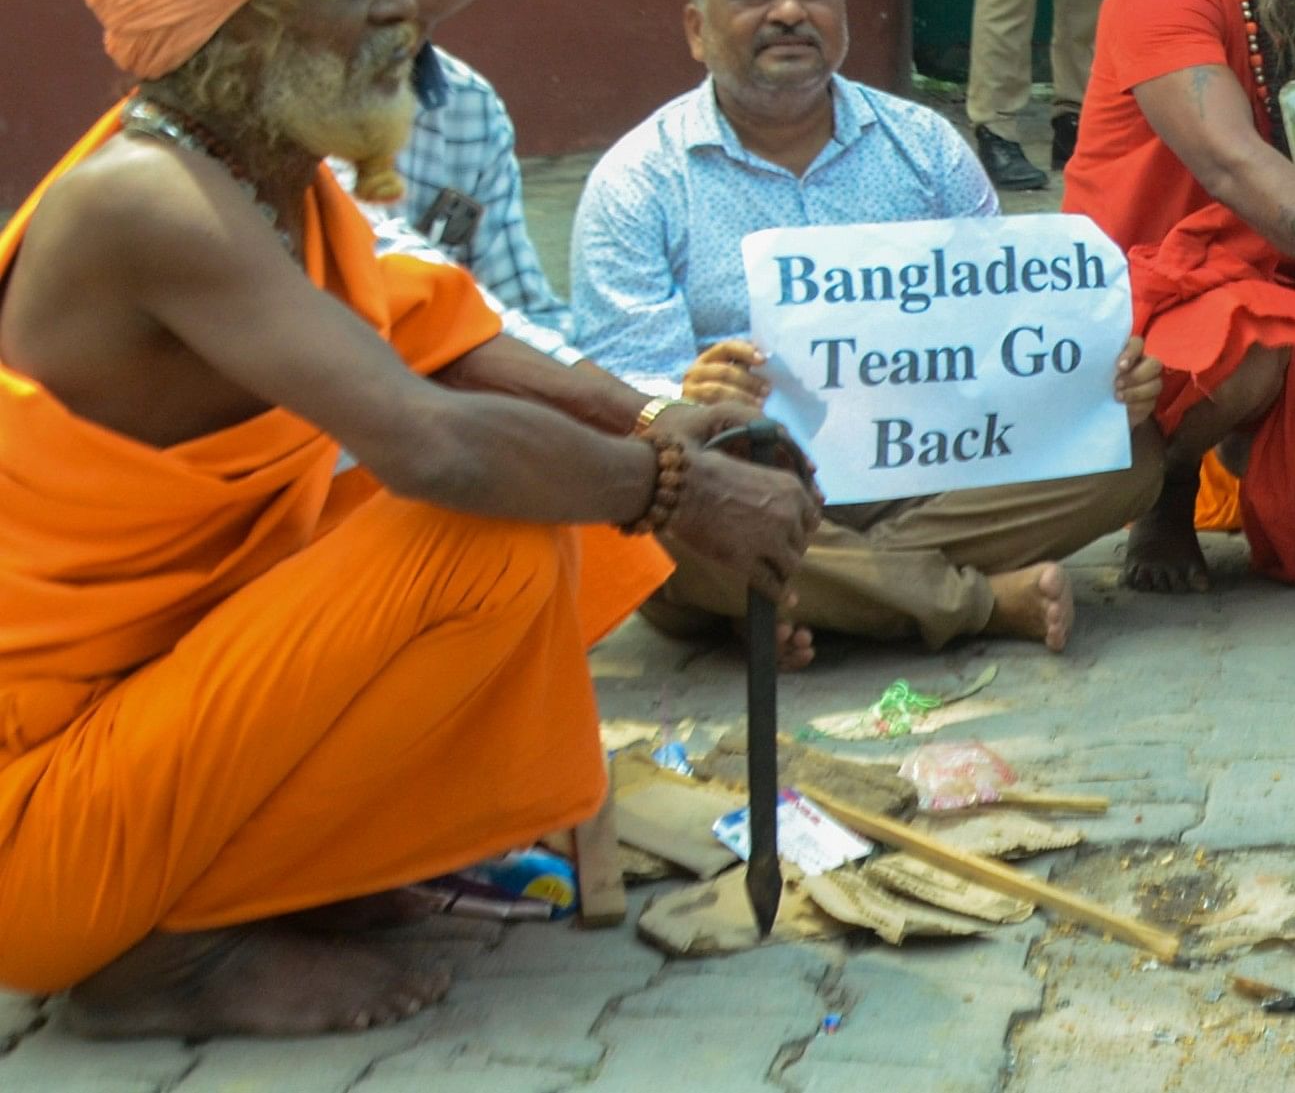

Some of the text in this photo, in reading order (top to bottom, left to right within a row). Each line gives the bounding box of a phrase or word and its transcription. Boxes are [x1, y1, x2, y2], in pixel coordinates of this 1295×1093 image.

[773, 242, 1107, 314] Bangladesh
[809, 324, 1082, 391] Team Go
[868, 412, 1016, 471] Back
